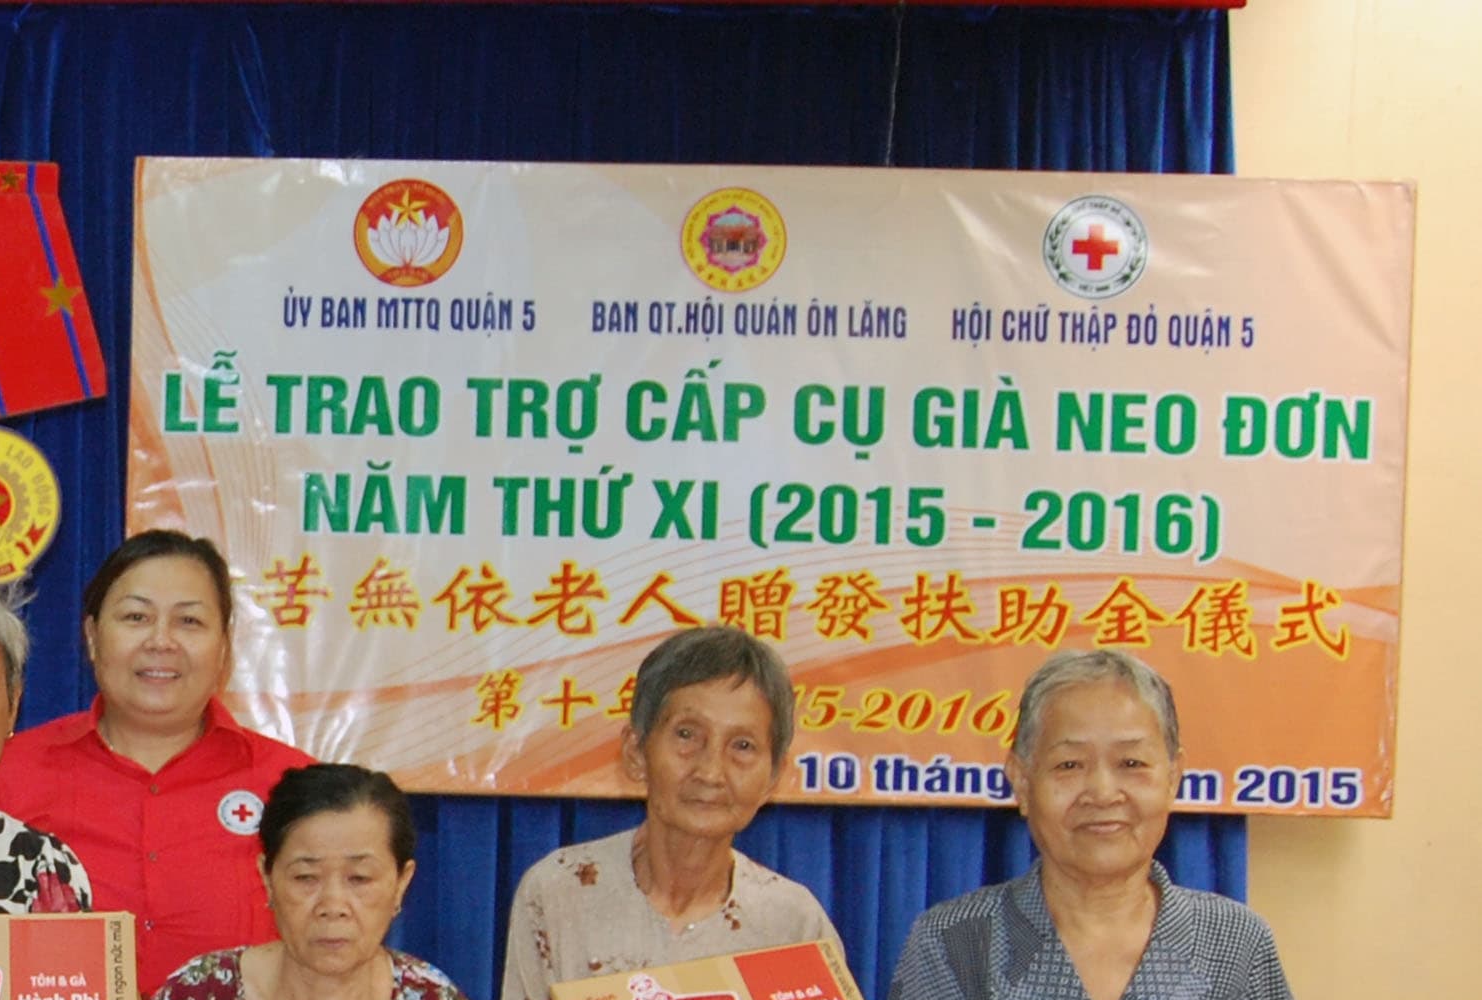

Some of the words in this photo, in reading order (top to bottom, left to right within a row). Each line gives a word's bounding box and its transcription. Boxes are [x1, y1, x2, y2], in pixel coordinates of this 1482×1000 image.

[283, 285, 313, 328] ỦY
[320, 297, 367, 329] BAN
[376, 296, 441, 331] MTTQ
[449, 291, 513, 339] QUẬN
[522, 300, 537, 332] 5
[592, 300, 639, 333] BAN
[734, 296, 798, 337] QUÁN
[807, 297, 839, 337] ÔN
[848, 300, 908, 339] LĂNG
[951, 301, 992, 348] HỘI
[1001, 303, 1051, 343] CHỮ
[1058, 305, 1118, 351] THẬP
[1126, 303, 1159, 346] ĐỎ
[1167, 308, 1232, 355] QUẬN
[1240, 316, 1255, 348] 5
[163, 350, 240, 434] LỄ
[266, 373, 441, 438] TRAO
[466, 373, 601, 454] TRỢ
[624, 359, 768, 444] CẤP
[792, 384, 887, 461] CỤ
[911, 376, 1030, 452] GIÀ
[1055, 391, 1199, 455] NEO
[1222, 393, 1372, 461] ĐƠN
[303, 461, 468, 535] NĂM
[492, 465, 632, 540] THỨ
[649, 480, 718, 541] XI
[749, 482, 946, 549] (2015
[971, 516, 997, 528] -
[1020, 490, 1221, 560] 2016)
[799, 756, 856, 790] 10
[874, 757, 1015, 800] tháng
[1236, 768, 1359, 805] 2015
[113, 965, 127, 995] ngon
